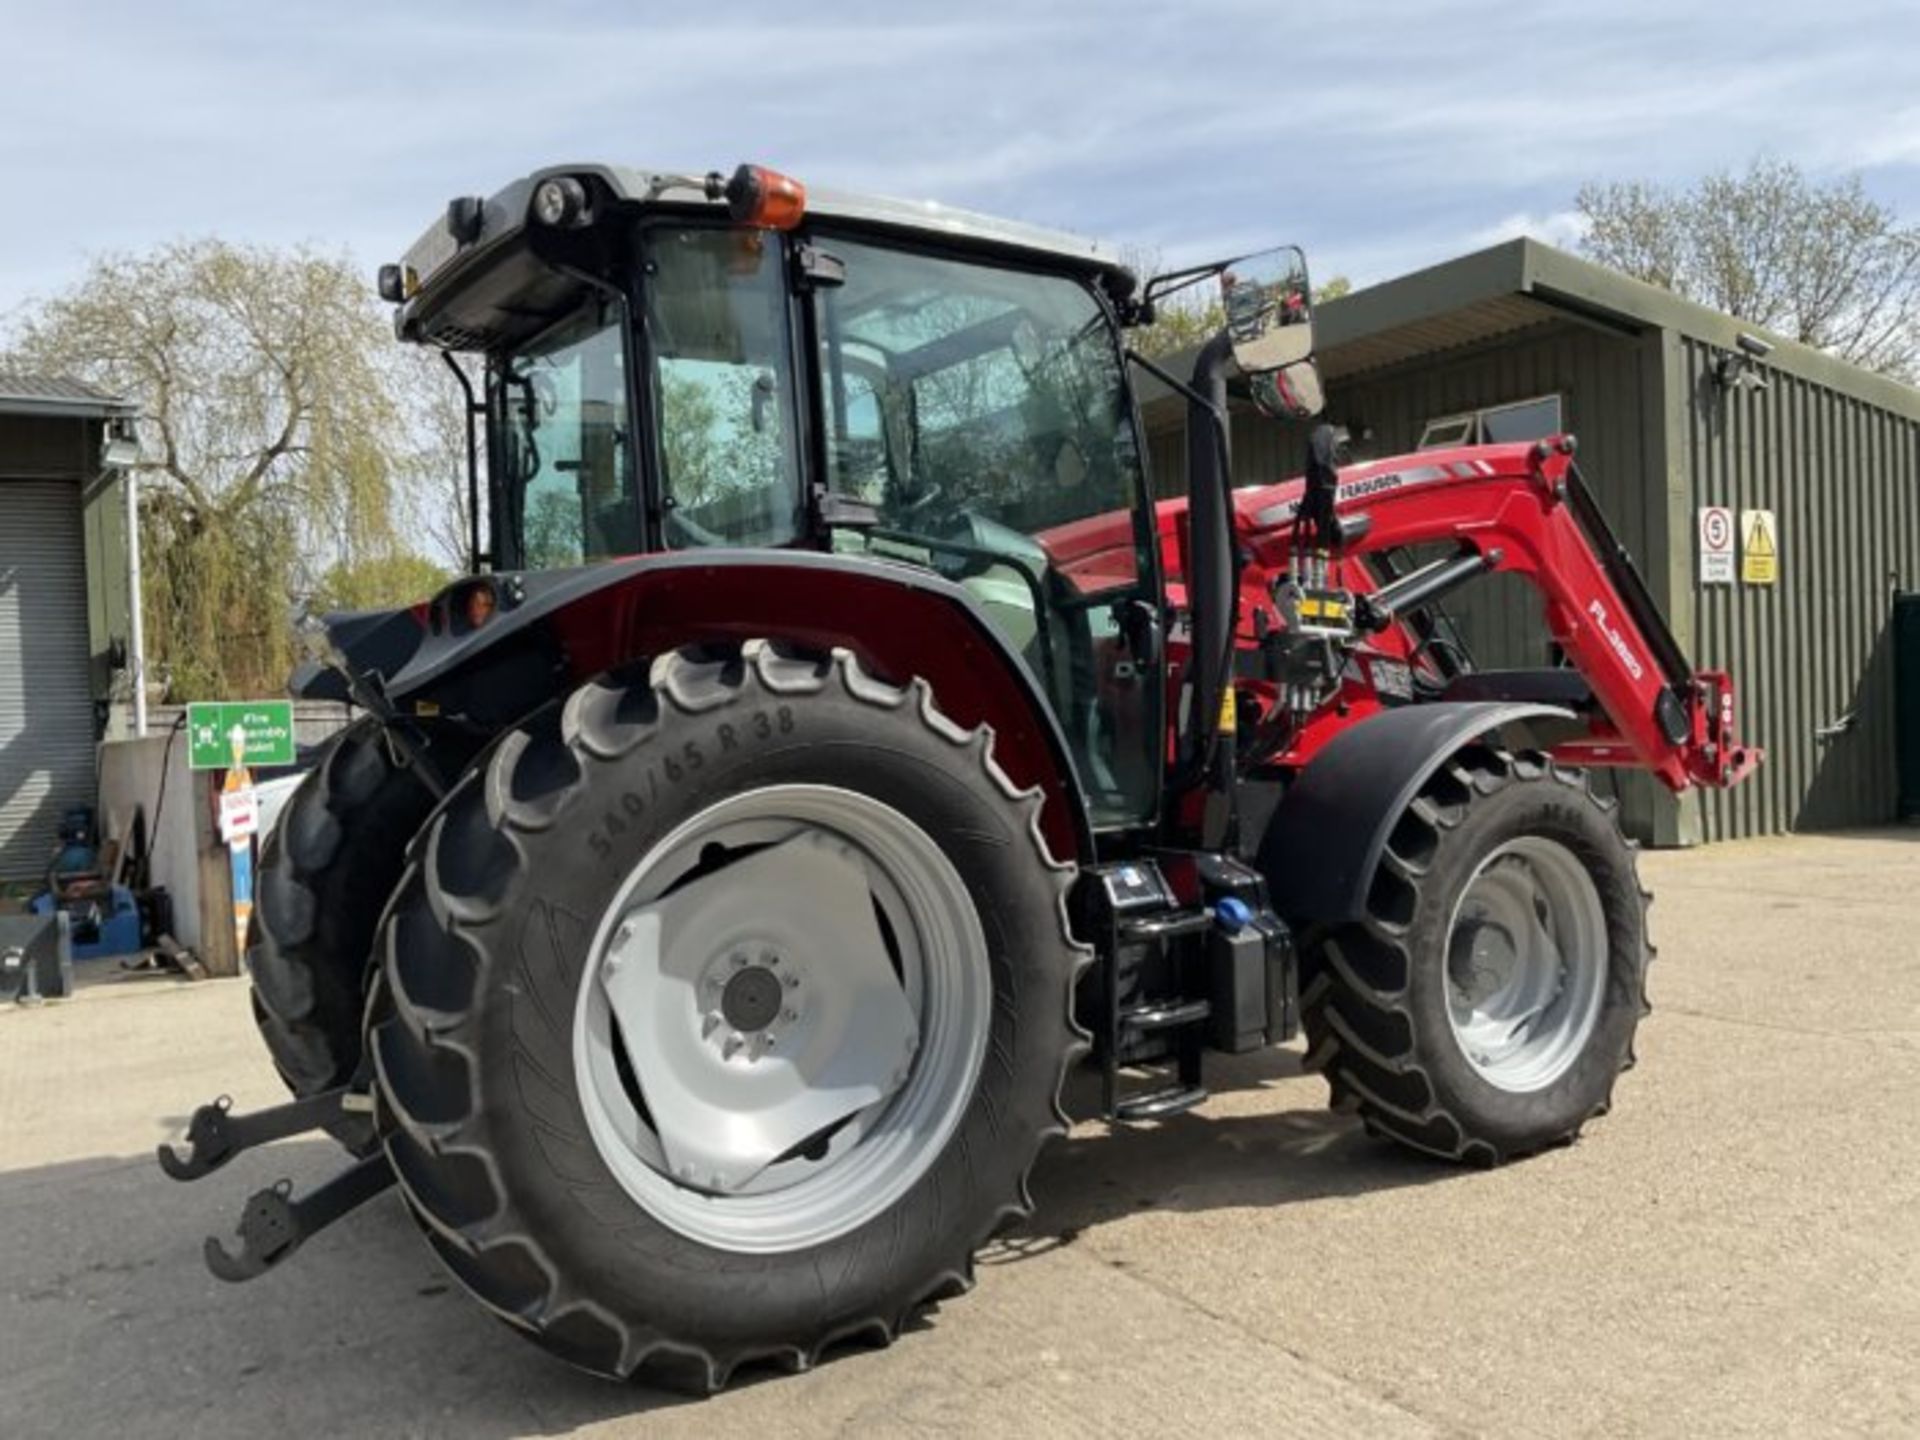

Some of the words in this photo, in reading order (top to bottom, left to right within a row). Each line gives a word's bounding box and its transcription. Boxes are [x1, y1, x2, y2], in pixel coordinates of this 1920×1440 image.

[1711, 519, 1721, 540] 5
[716, 723, 738, 750] R
[752, 705, 794, 739] 38
